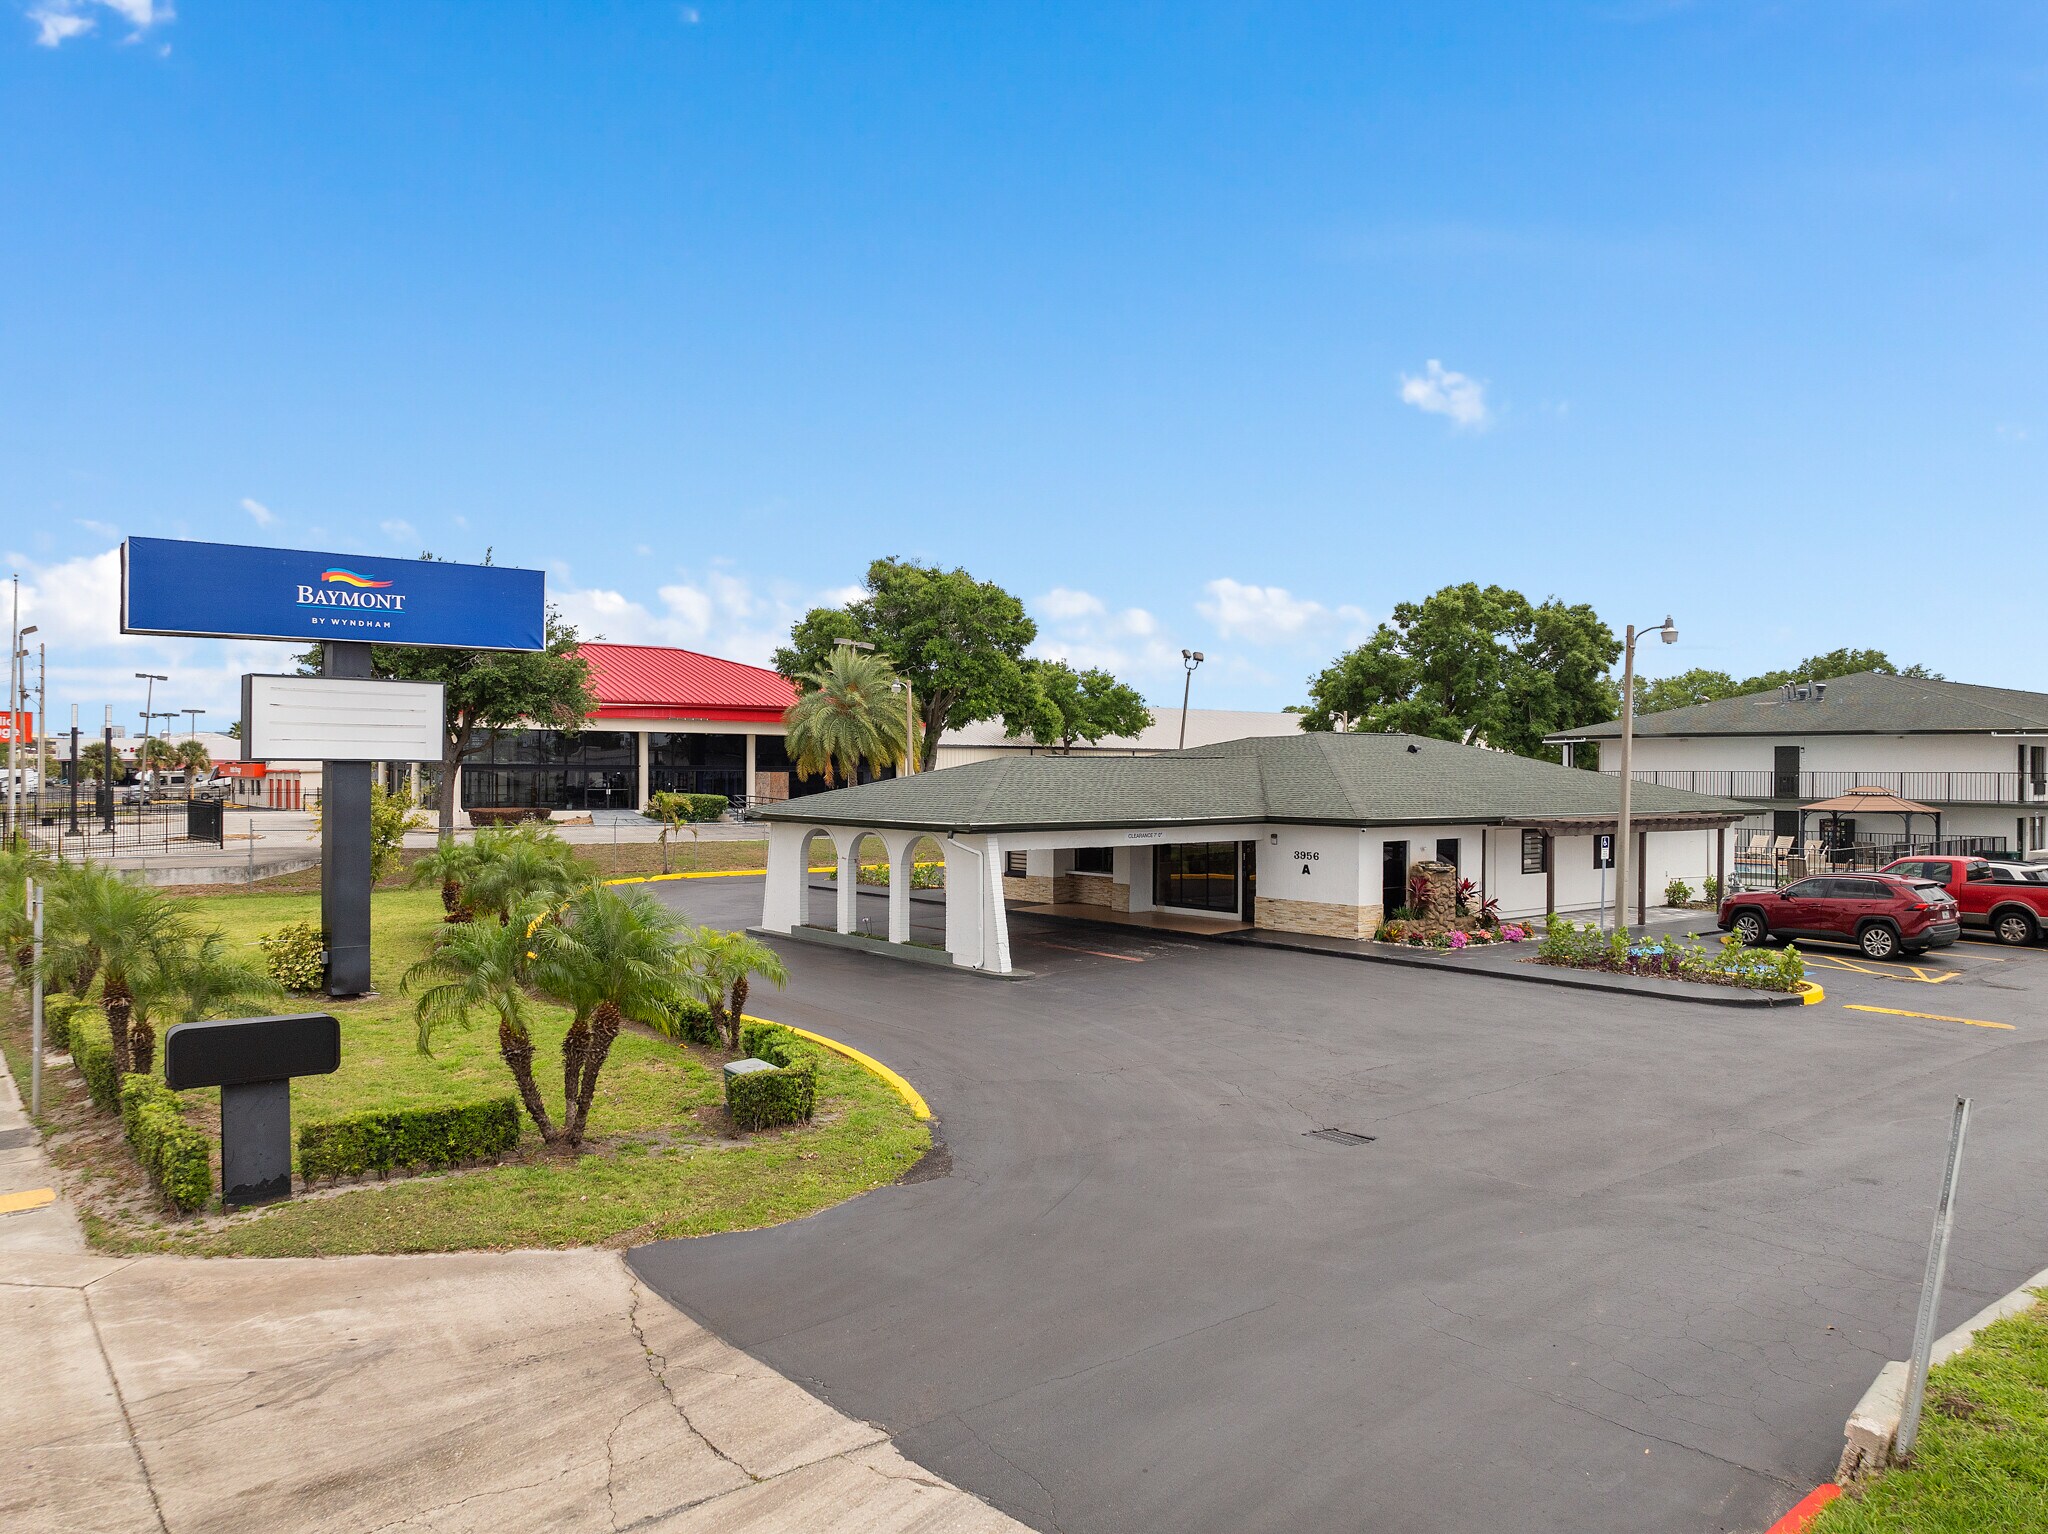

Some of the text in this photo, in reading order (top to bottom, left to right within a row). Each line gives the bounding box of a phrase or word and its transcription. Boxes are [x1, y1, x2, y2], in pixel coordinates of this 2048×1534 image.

[296, 585, 406, 610] BAYMONT
[311, 617, 391, 628] BY WYNDHAM
[1293, 850, 1320, 861] 3956
[1302, 864, 1311, 875] A
